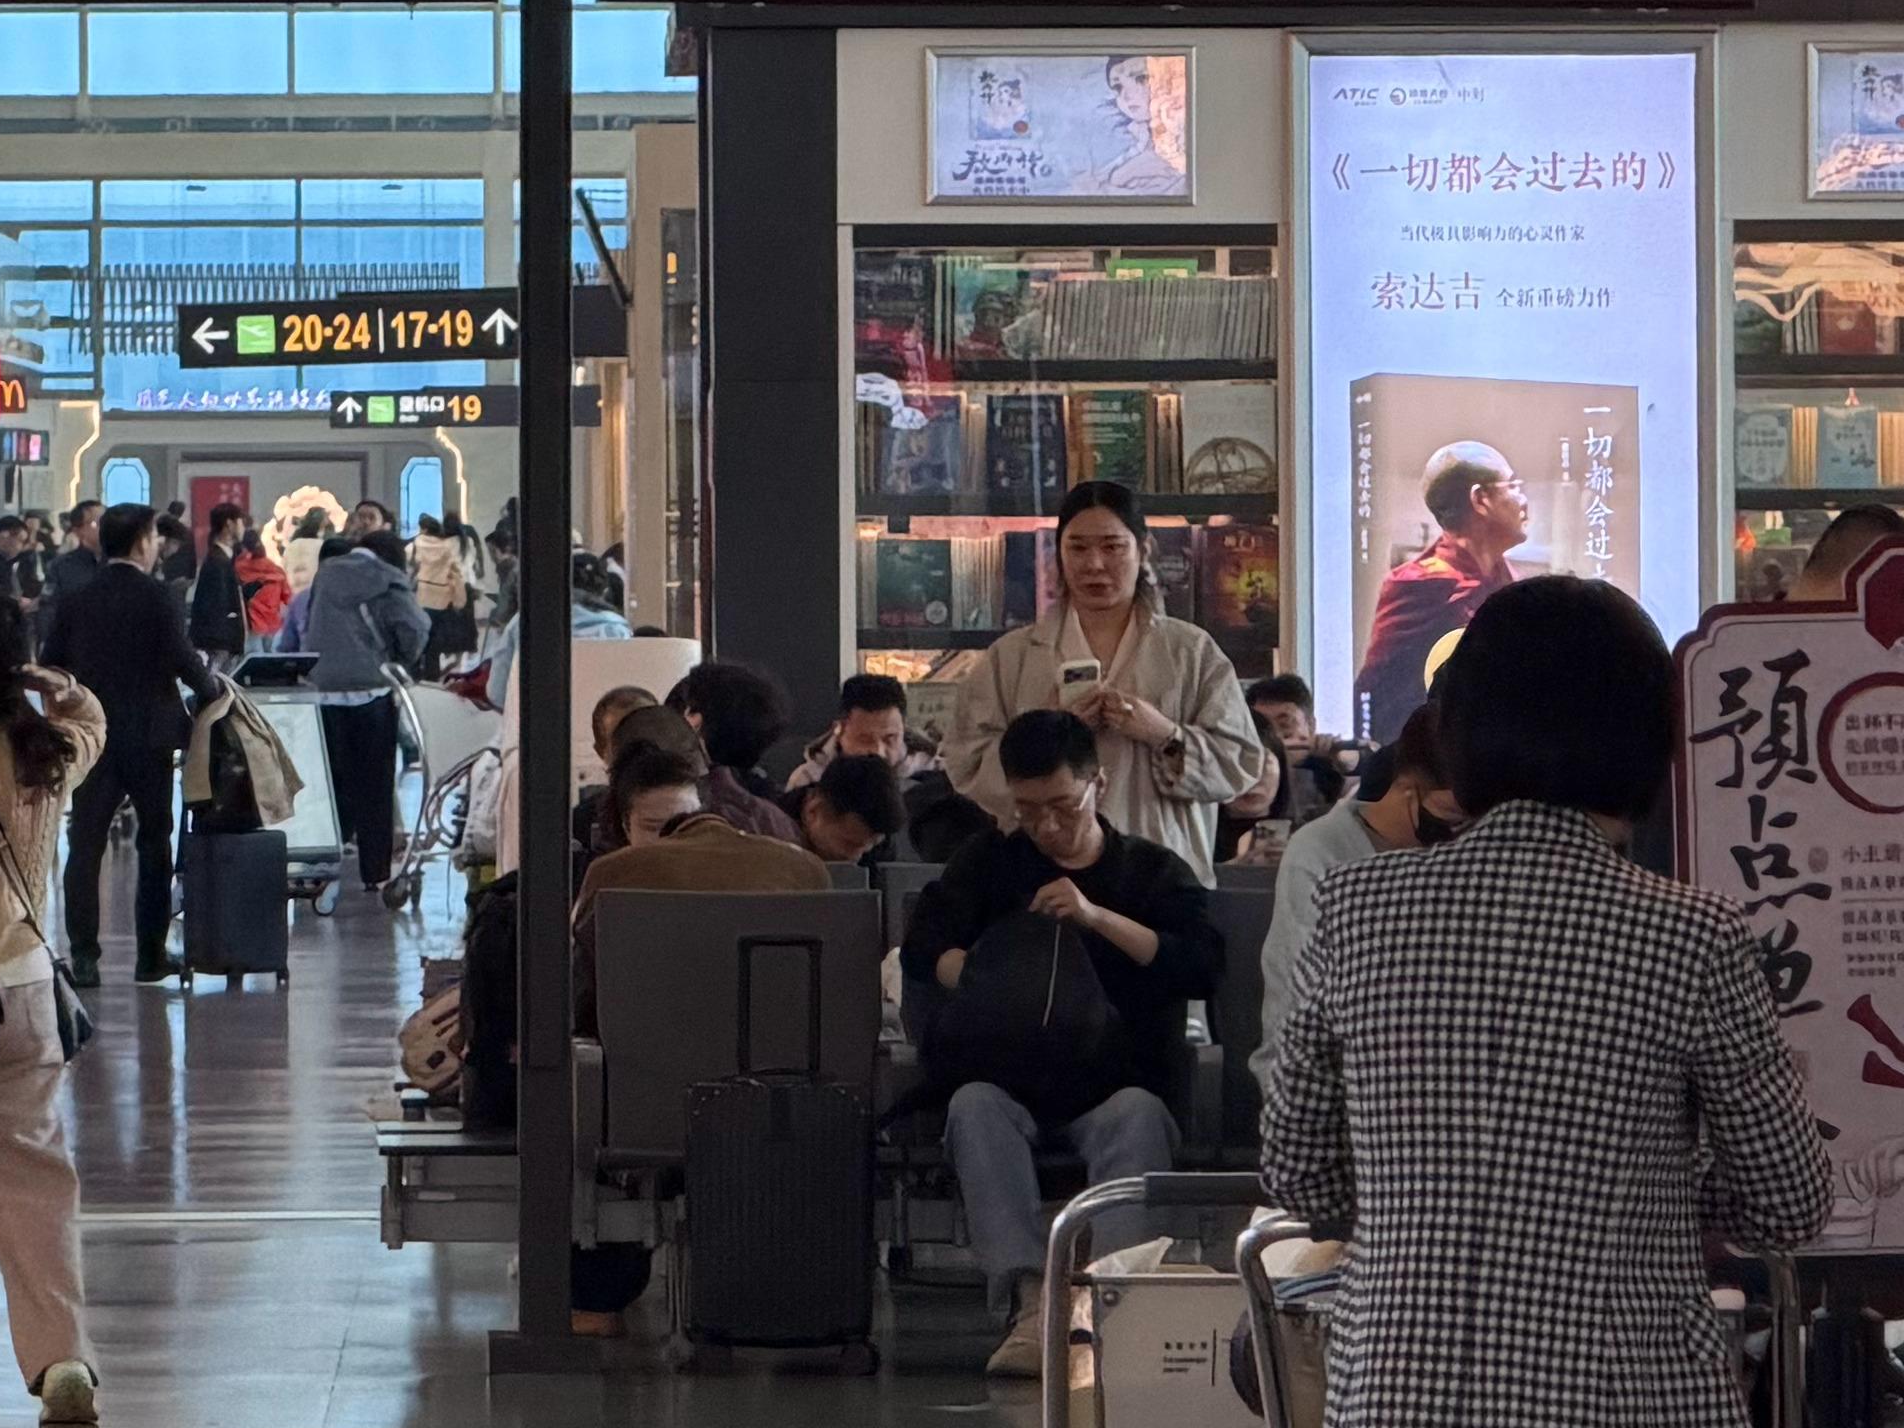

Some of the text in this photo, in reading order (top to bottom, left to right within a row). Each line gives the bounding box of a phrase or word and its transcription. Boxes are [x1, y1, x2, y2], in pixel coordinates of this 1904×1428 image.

[1332, 151, 1676, 194] 《一切都会过去的》
[1369, 271, 1487, 311] 索达吉
[282, 308, 475, 352] 20-24 17-19
[447, 394, 483, 423] 19
